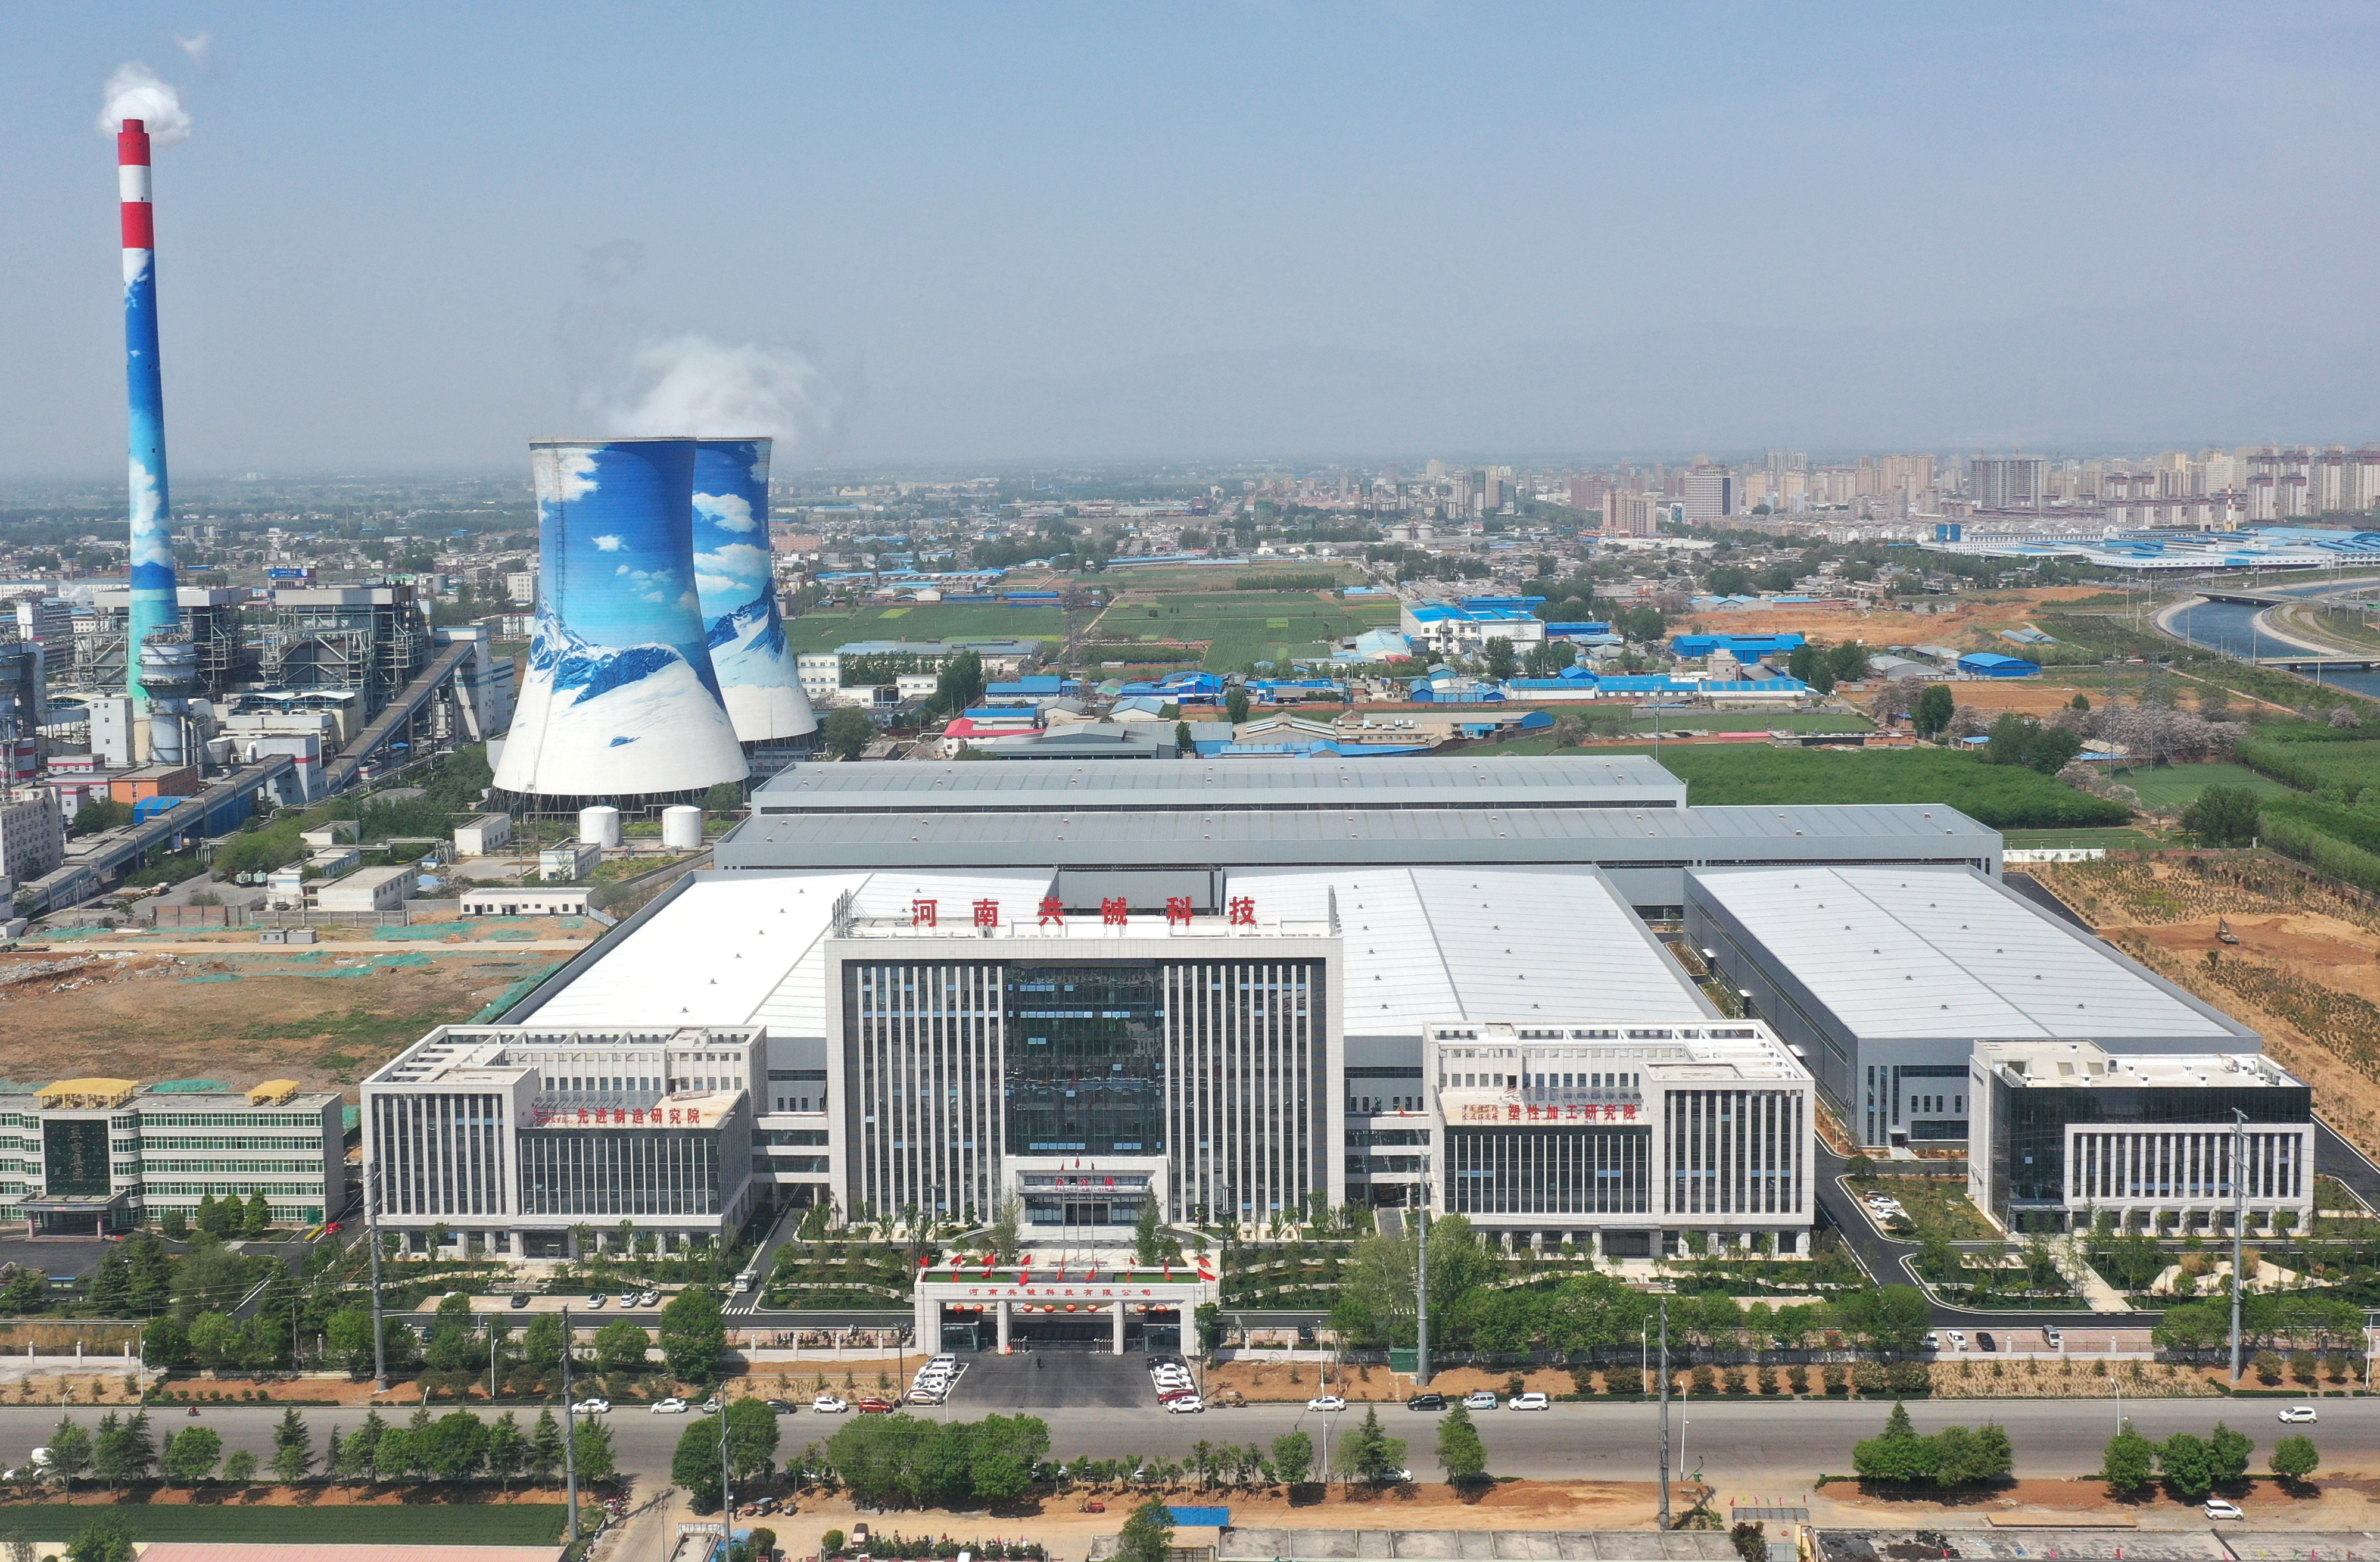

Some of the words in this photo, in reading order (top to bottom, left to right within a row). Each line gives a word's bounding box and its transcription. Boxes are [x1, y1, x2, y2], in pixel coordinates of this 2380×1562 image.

[911, 896, 1257, 927] 河南共铖科技
[577, 1108, 700, 1124] 先进制造研究院
[1508, 1104, 1637, 1120] 塑性加工研究院
[70, 1125, 84, 1181] 孟电集团
